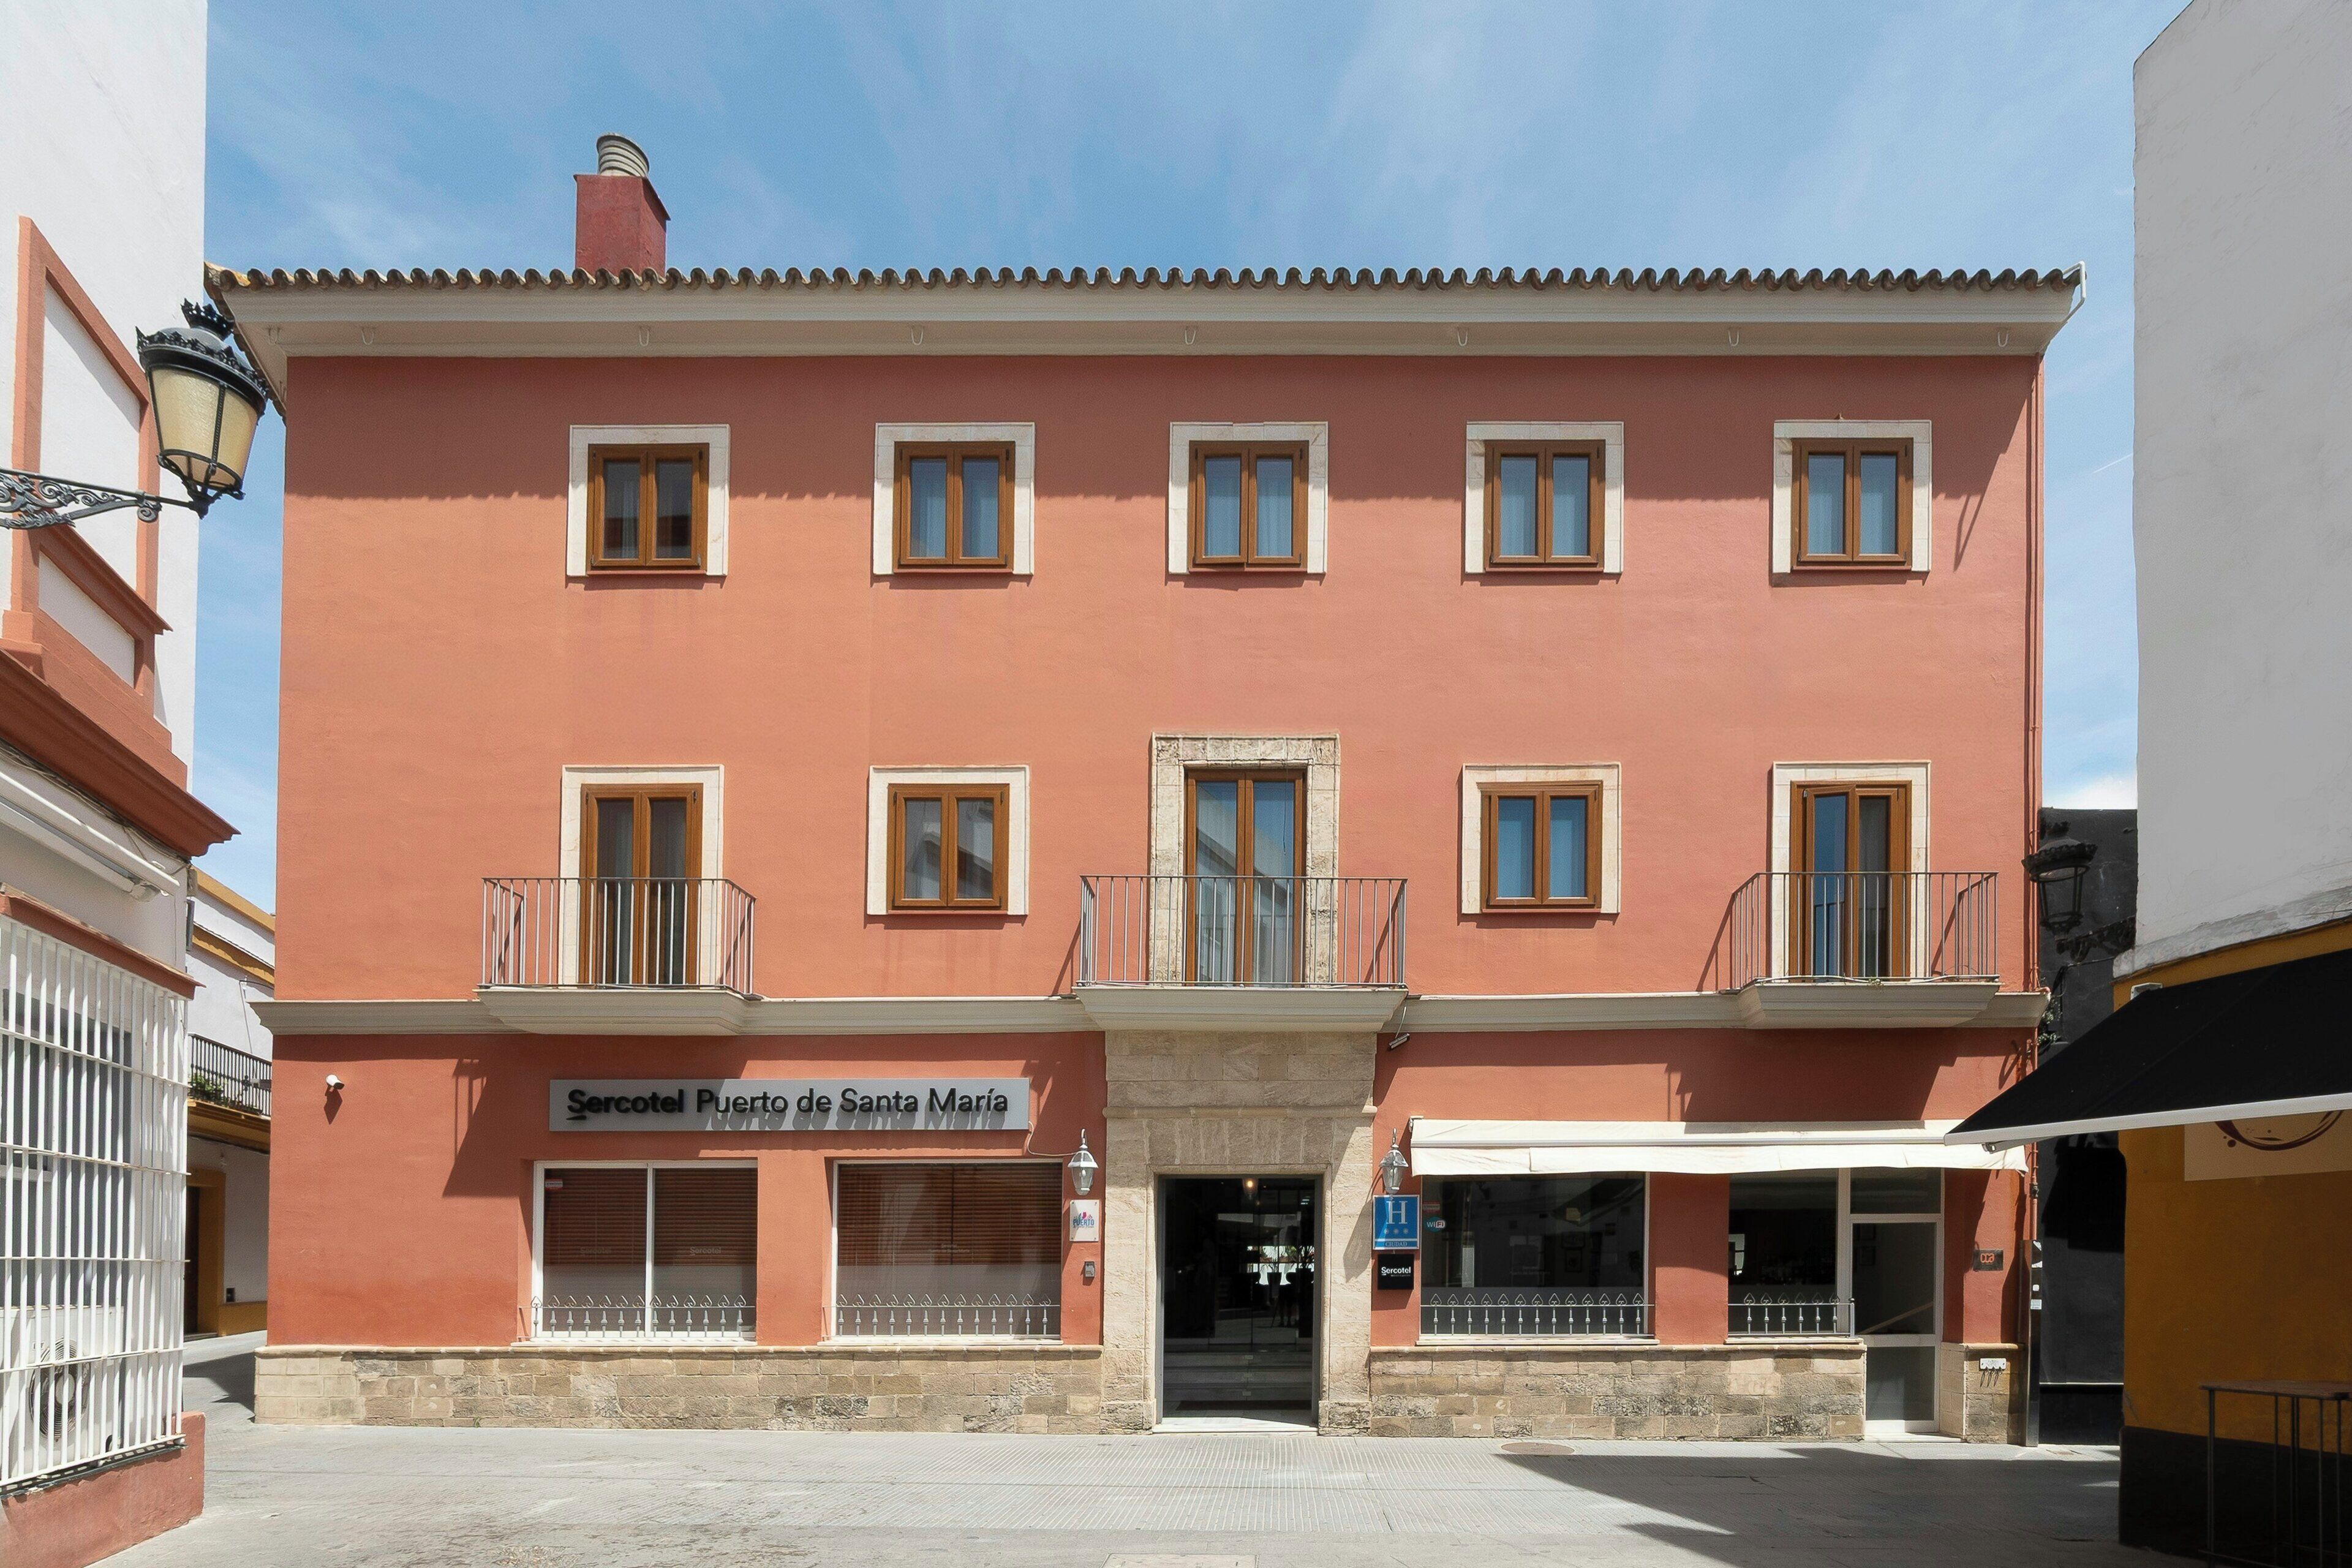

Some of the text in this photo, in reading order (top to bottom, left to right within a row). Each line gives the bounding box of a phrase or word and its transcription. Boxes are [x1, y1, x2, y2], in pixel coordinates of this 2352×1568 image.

[567, 1087, 1008, 1120] Sercotel Puerto de Santa María
[1386, 1200, 1408, 1224] H
[1381, 1266, 1411, 1275] Sercotel
